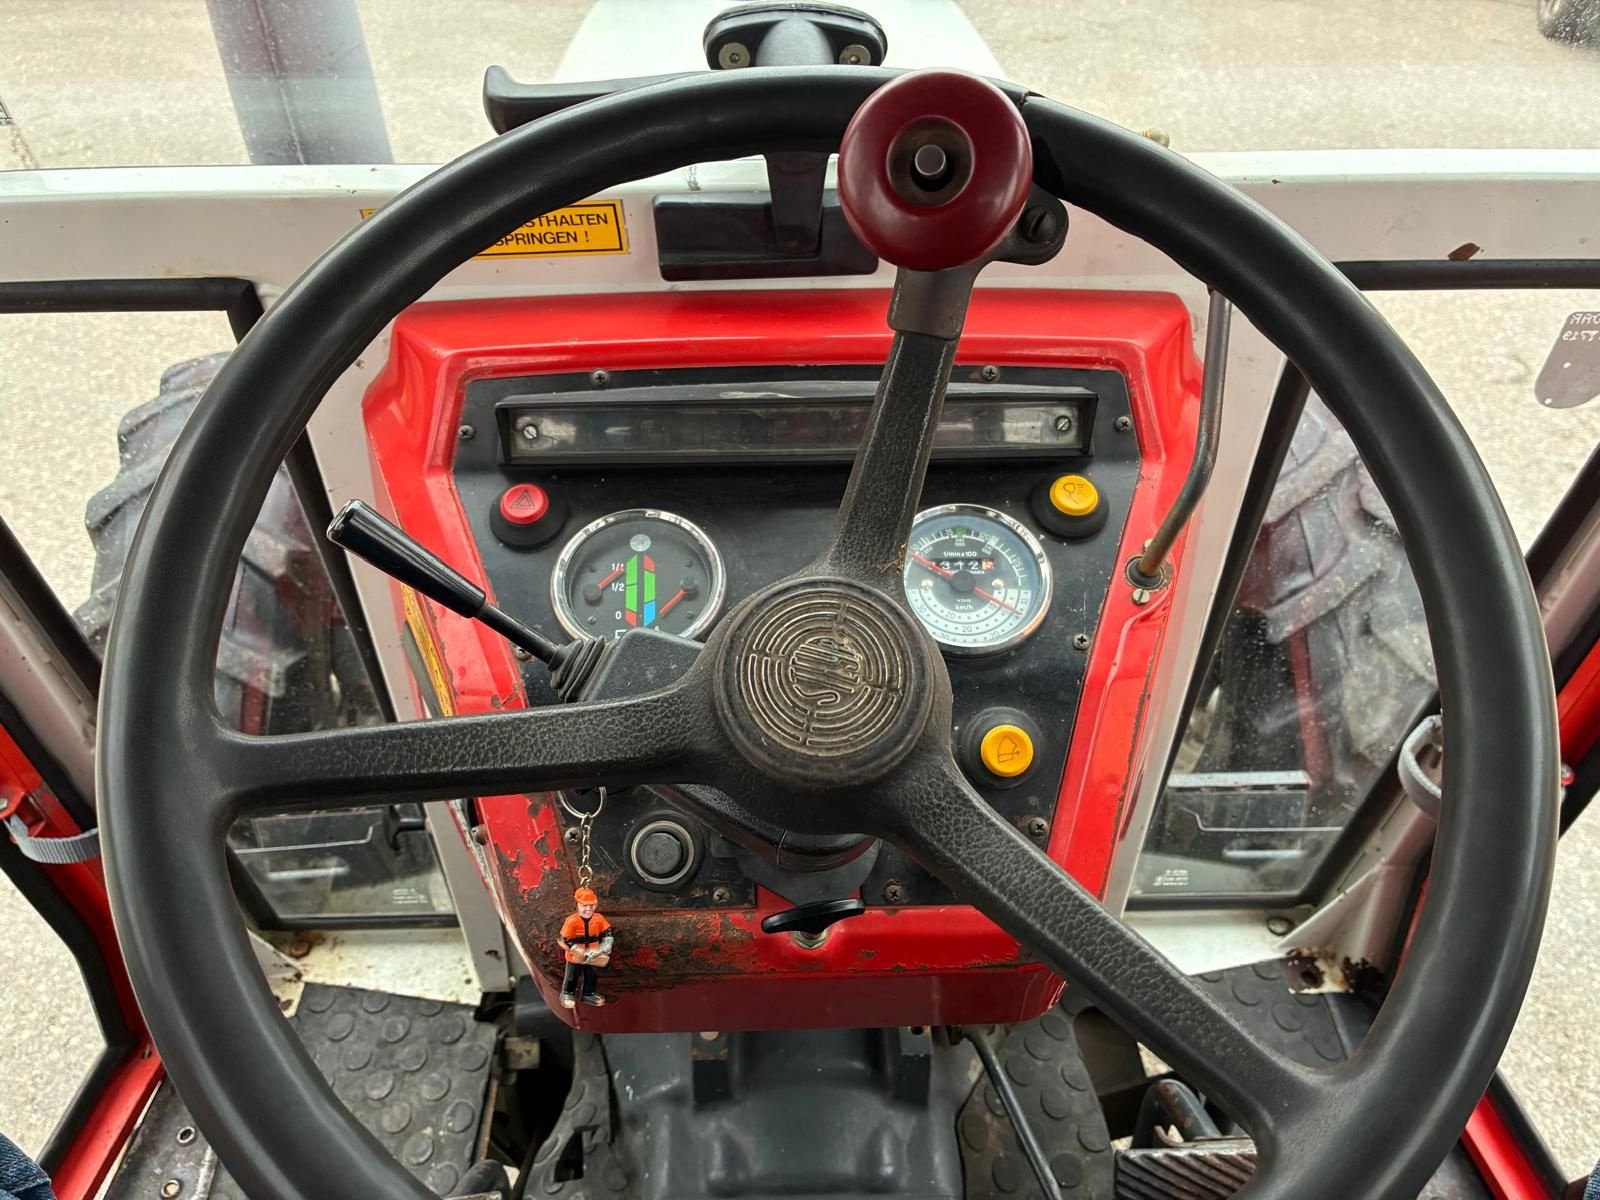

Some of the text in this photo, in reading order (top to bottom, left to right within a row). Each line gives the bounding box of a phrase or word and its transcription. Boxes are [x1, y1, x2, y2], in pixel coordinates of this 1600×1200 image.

[521, 213, 608, 228] STHALTEN
[611, 582, 625, 592] 1/2
[615, 611, 622, 620] 0
[961, 625, 973, 633] 20
